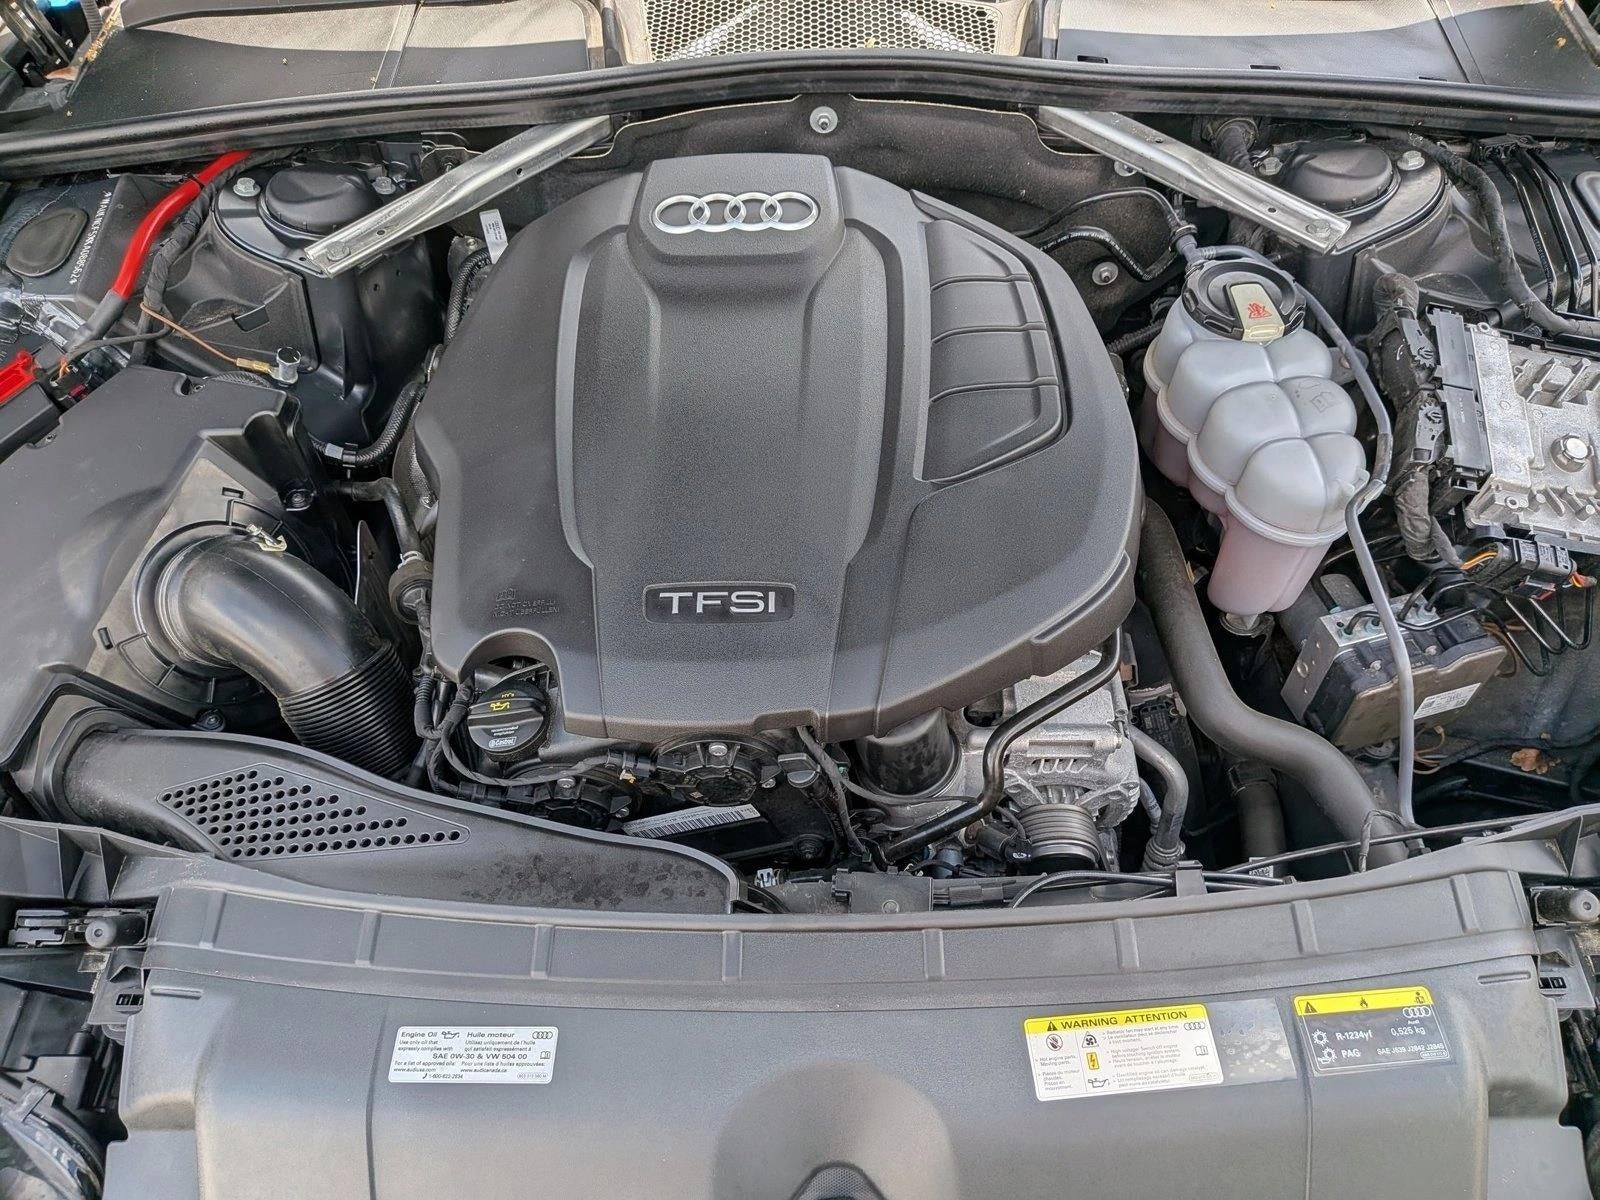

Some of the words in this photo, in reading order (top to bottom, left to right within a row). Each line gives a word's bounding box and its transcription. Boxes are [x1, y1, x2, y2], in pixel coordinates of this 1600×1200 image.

[659, 591, 776, 614] TFSI
[1060, 1017, 1118, 1029] WARNING
[1124, 1011, 1188, 1024] ATTENTION
[401, 1031, 426, 1039] Engine
[1335, 1030, 1374, 1041] R-1234yf
[1391, 1026, 1413, 1036] 0,525
[1414, 1025, 1426, 1035] kg
[1341, 1049, 1361, 1058] PAG
[1377, 1047, 1391, 1056] SAE
